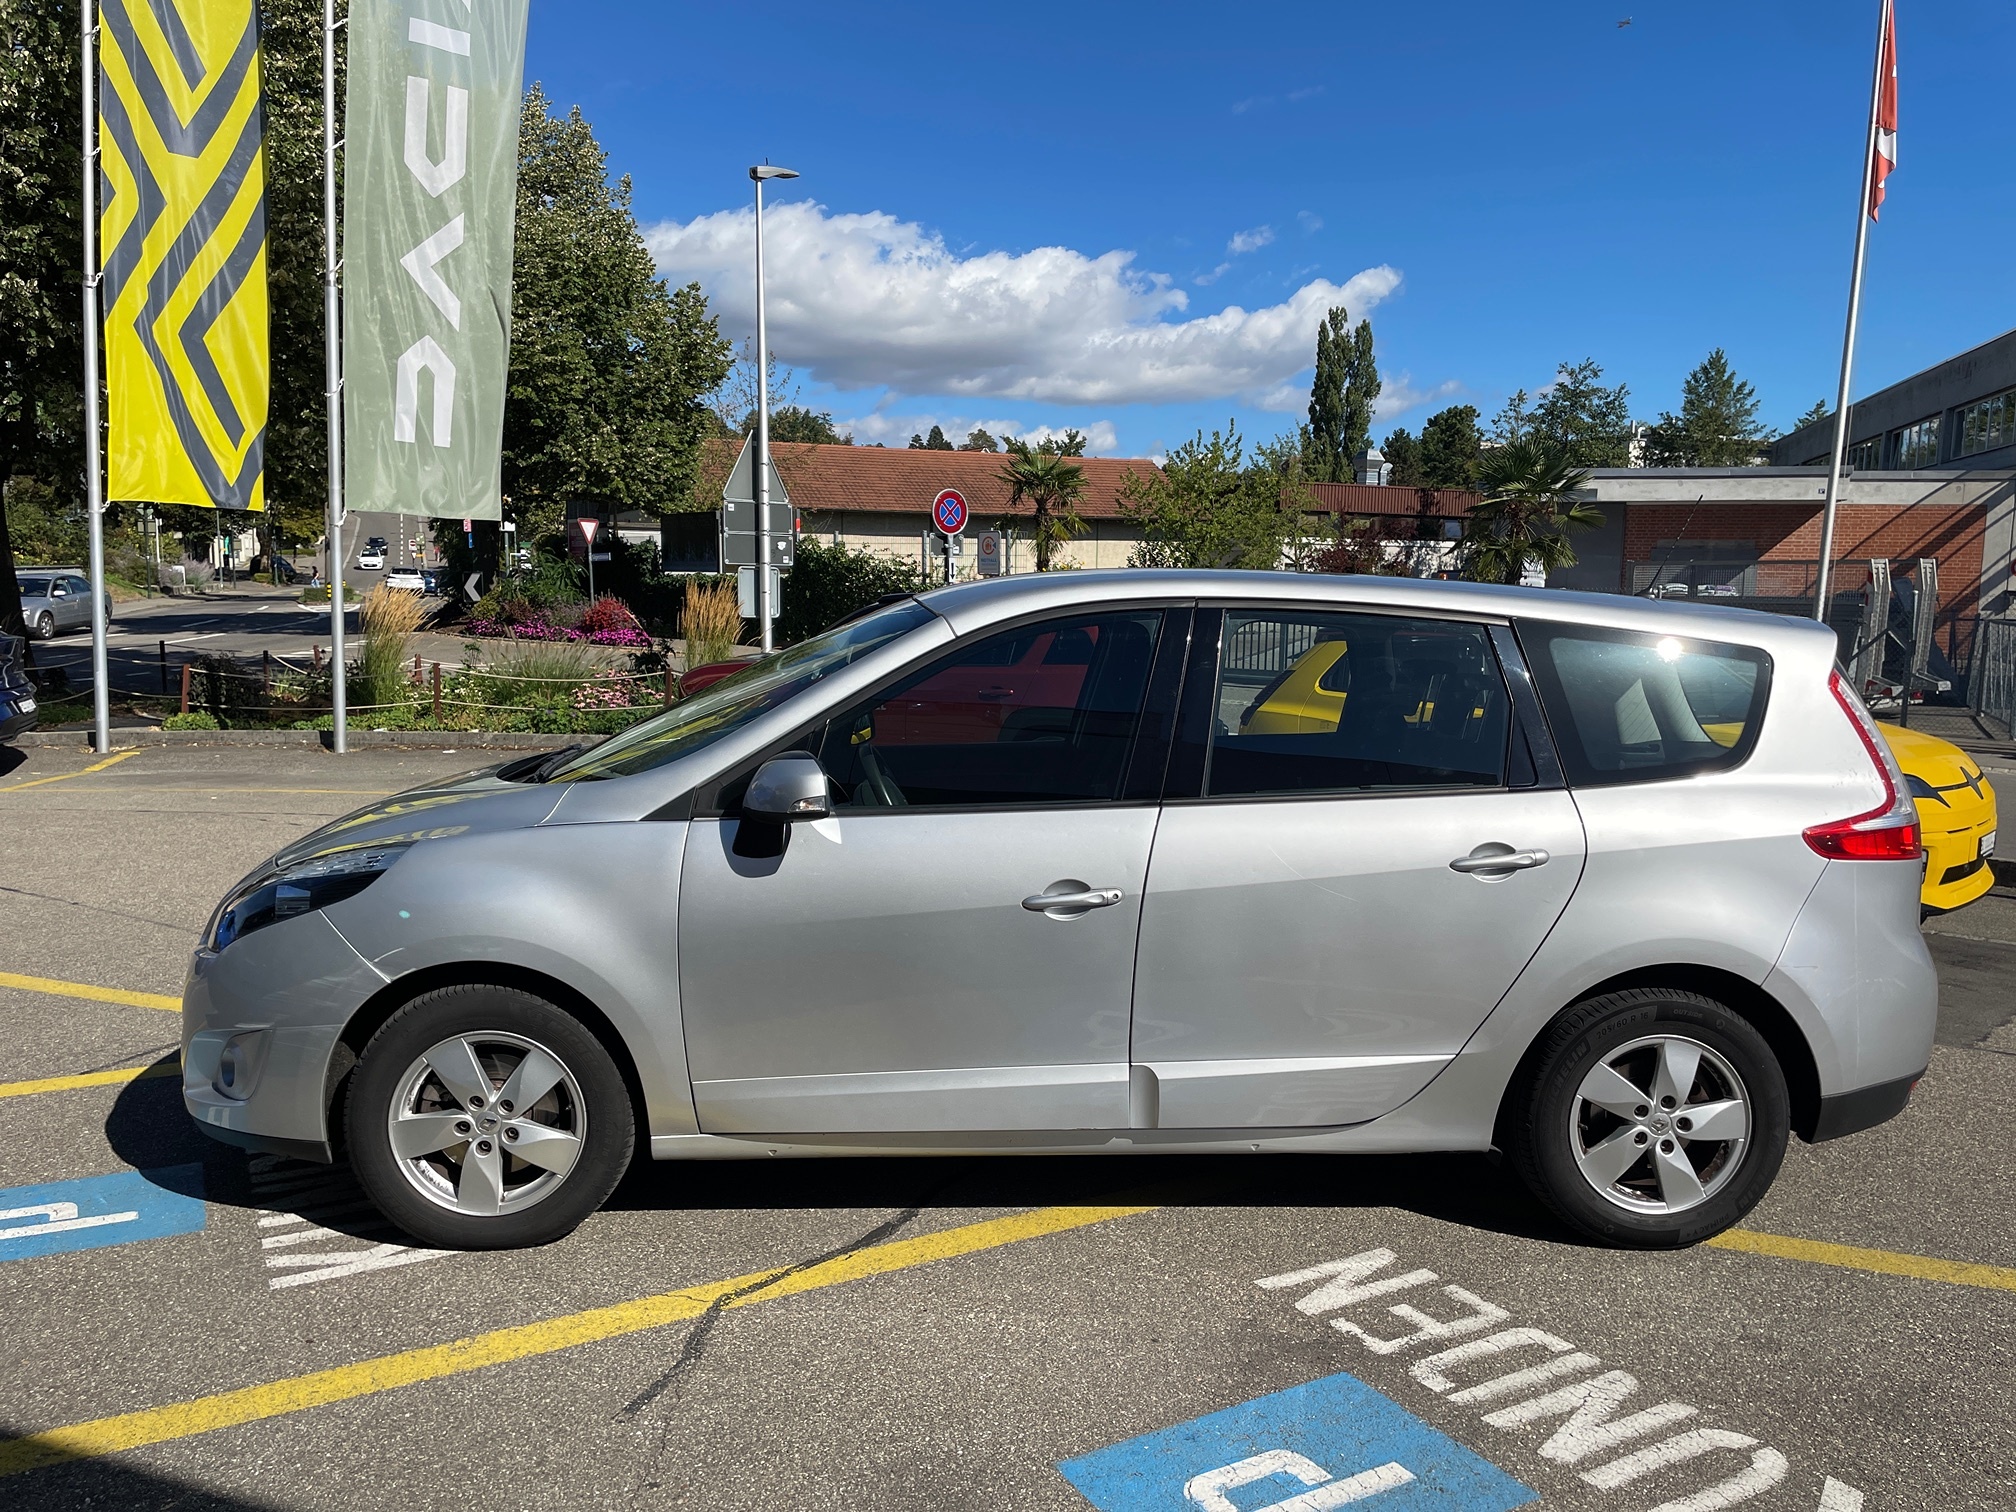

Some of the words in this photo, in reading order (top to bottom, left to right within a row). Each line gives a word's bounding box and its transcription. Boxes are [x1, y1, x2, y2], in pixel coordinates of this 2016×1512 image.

[394, 0, 471, 448] DACI
[1673, 1008, 1704, 1019] OUTSIDE
[1254, 1246, 1864, 1512] UNDEN
